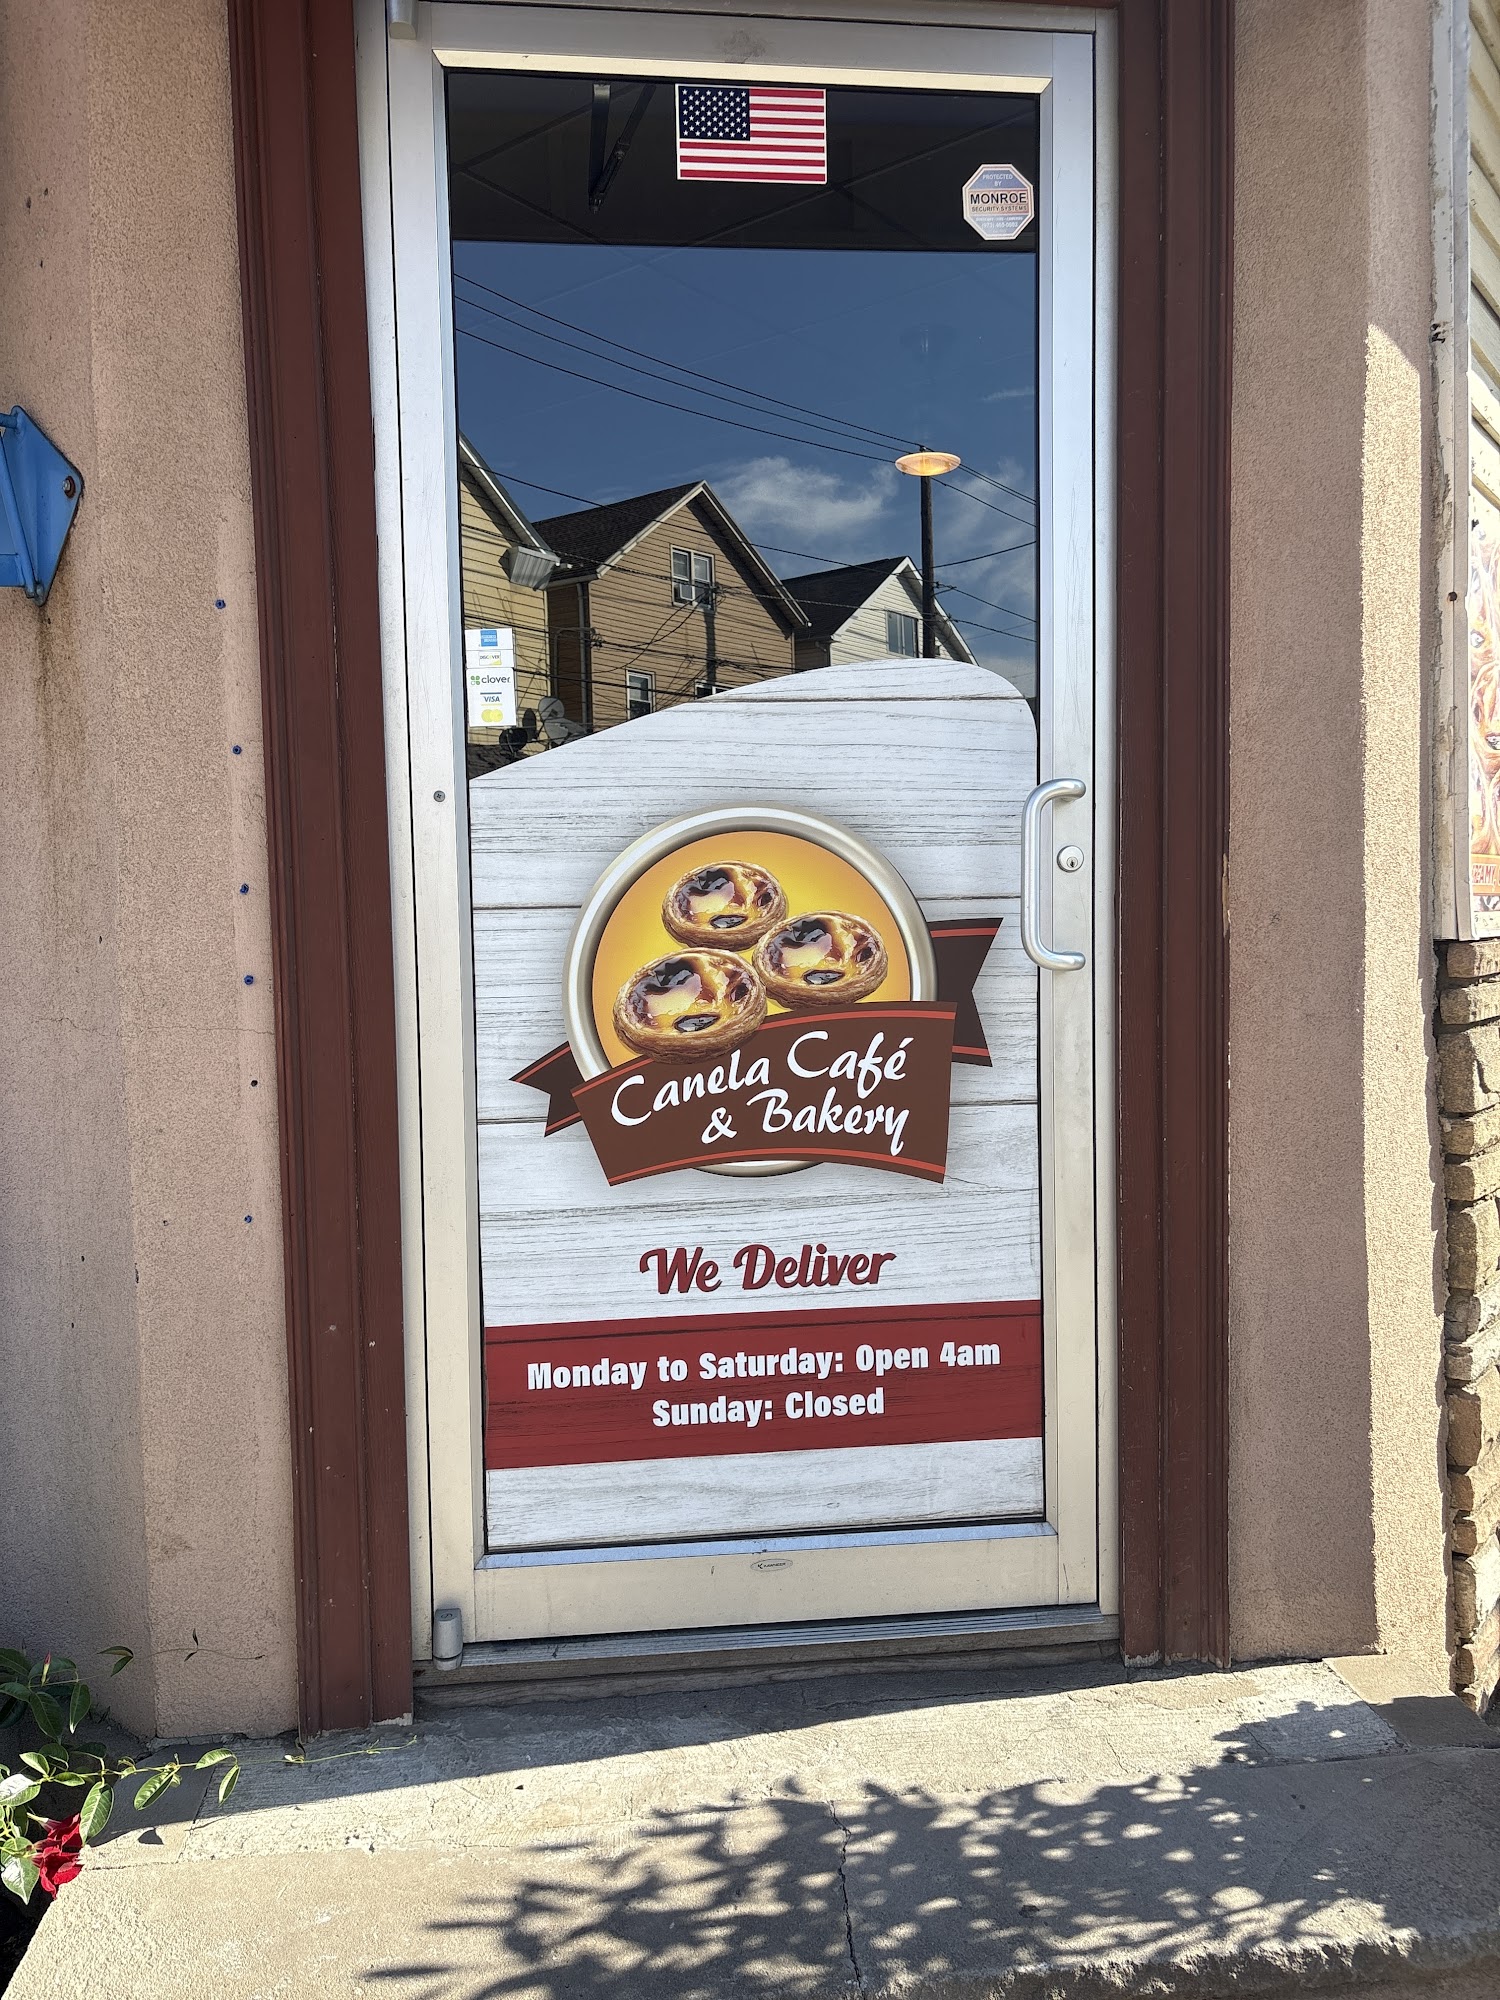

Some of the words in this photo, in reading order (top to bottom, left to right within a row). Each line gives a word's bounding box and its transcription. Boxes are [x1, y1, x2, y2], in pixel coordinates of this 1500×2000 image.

[970, 192, 1027, 205] MONROE
[481, 674, 511, 684] clover
[483, 695, 500, 703] VISA
[611, 1049, 770, 1127] Canela
[787, 1030, 914, 1098] Café
[701, 1106, 738, 1145] &
[746, 1087, 910, 1156] Bakery
[639, 1246, 723, 1295] We
[732, 1243, 897, 1290] Deliver
[527, 1358, 647, 1391] Monday
[656, 1355, 689, 1383] to
[699, 1347, 844, 1381] Saturday:
[855, 1341, 930, 1376] Open
[939, 1341, 1001, 1368] 4am
[652, 1394, 773, 1429] Sunday:
[785, 1387, 885, 1421] Closed
